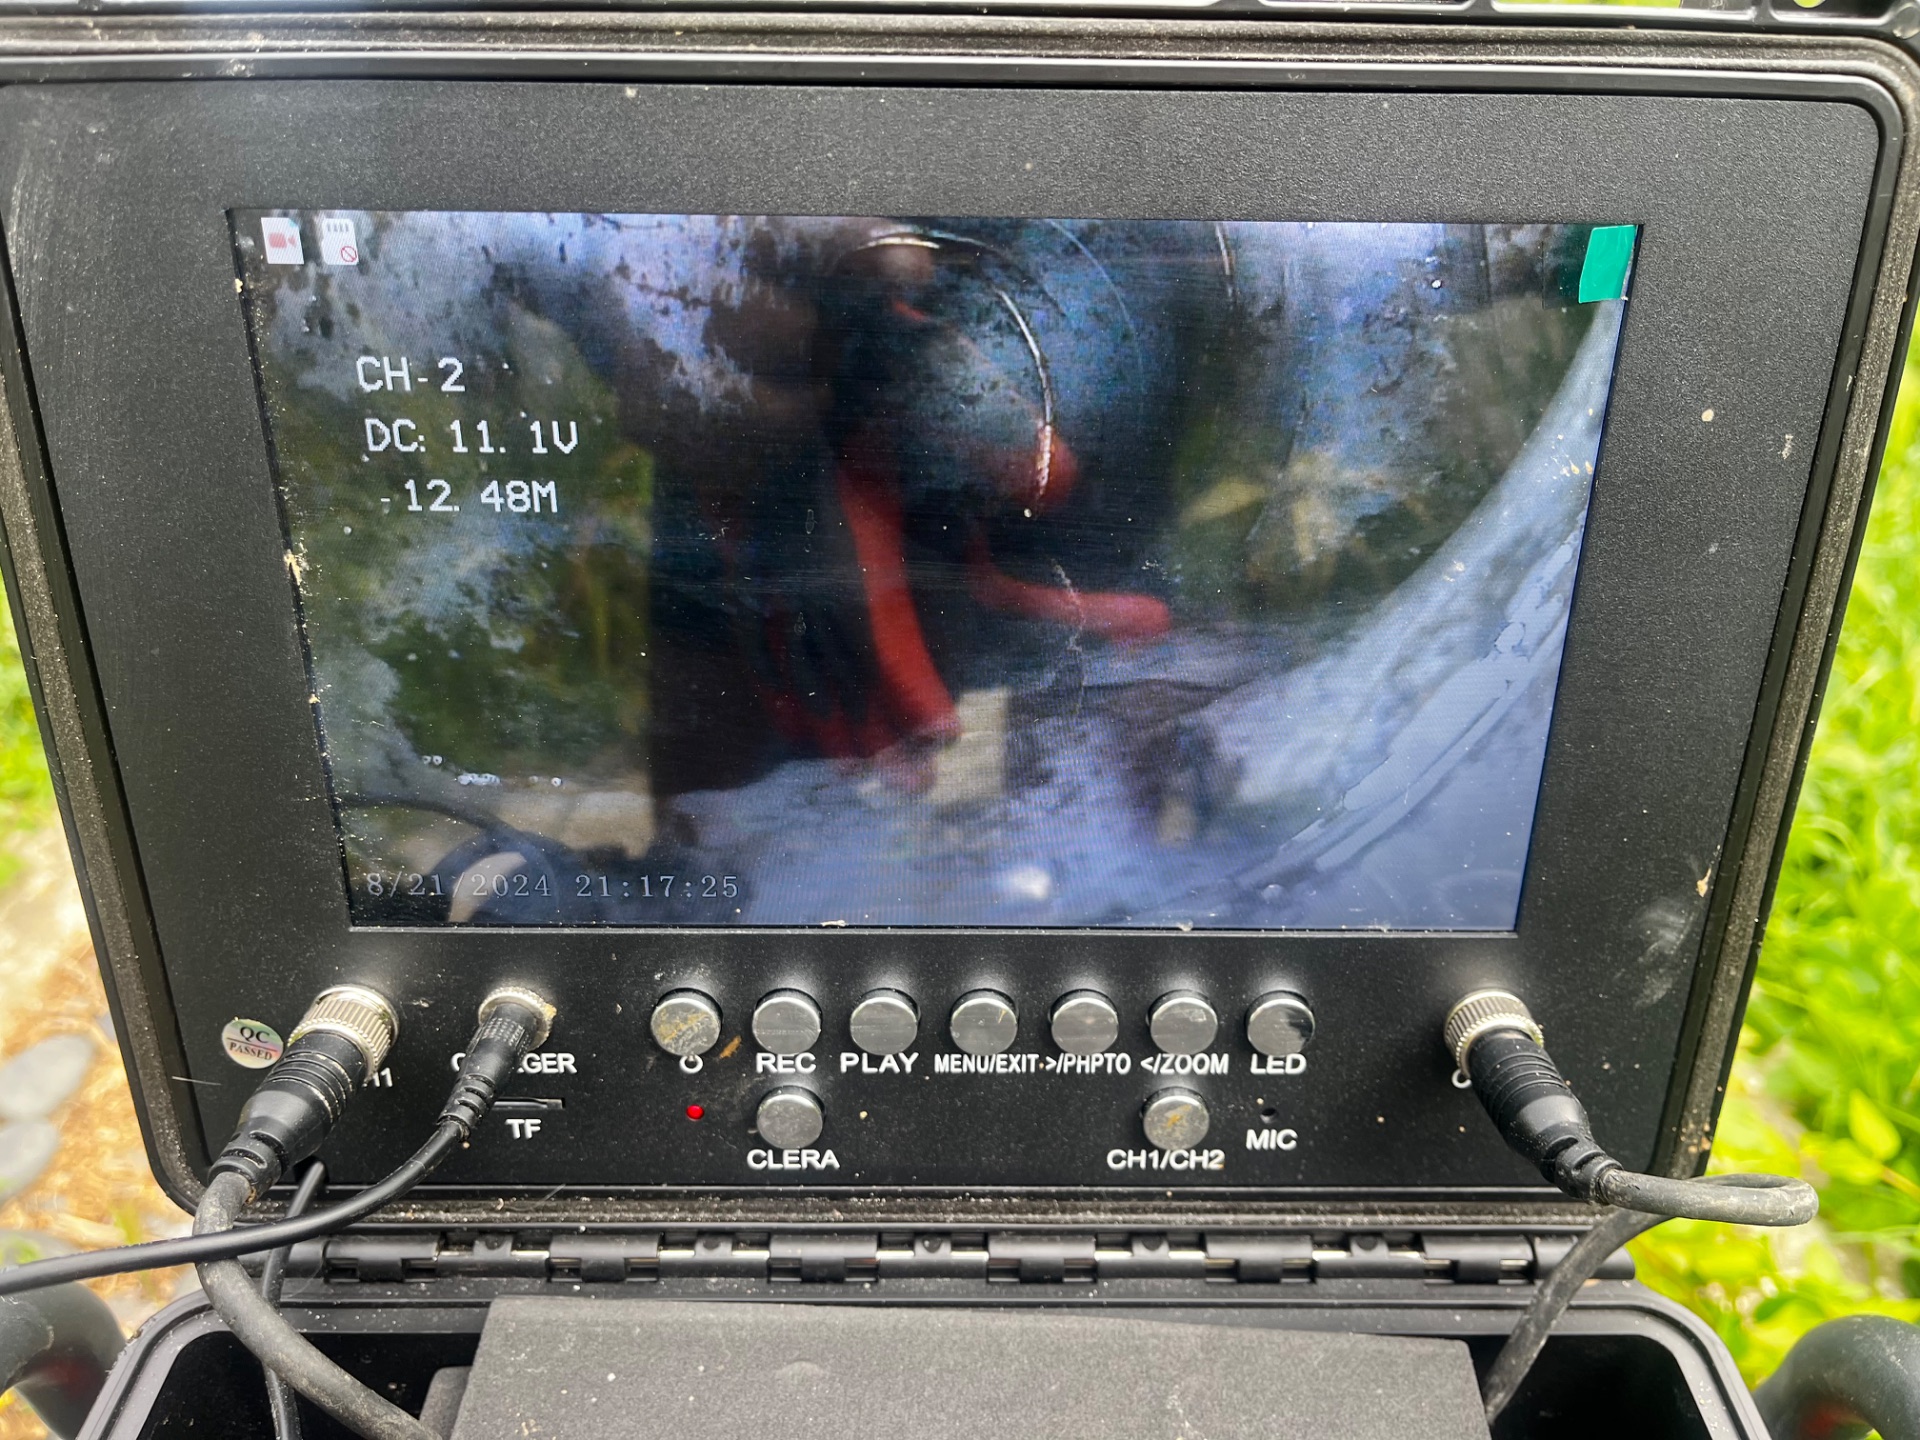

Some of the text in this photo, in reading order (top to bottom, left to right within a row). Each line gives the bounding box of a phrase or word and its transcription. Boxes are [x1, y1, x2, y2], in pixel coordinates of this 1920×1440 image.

[364, 418, 427, 452] DC:
[366, 871, 740, 899] 8/21/2024 21:17:25
[239, 1026, 270, 1044] QC
[228, 1042, 273, 1061] PASSED
[755, 1052, 817, 1074] REC
[839, 1052, 919, 1074] PLAY
[934, 1053, 1040, 1074] MENU/EXIT
[1250, 1054, 1307, 1075] LED
[505, 1117, 542, 1140] TF
[1245, 1128, 1298, 1151] MIC
[746, 1148, 841, 1170] CLERA
[1106, 1148, 1226, 1171] CH1/CH2
